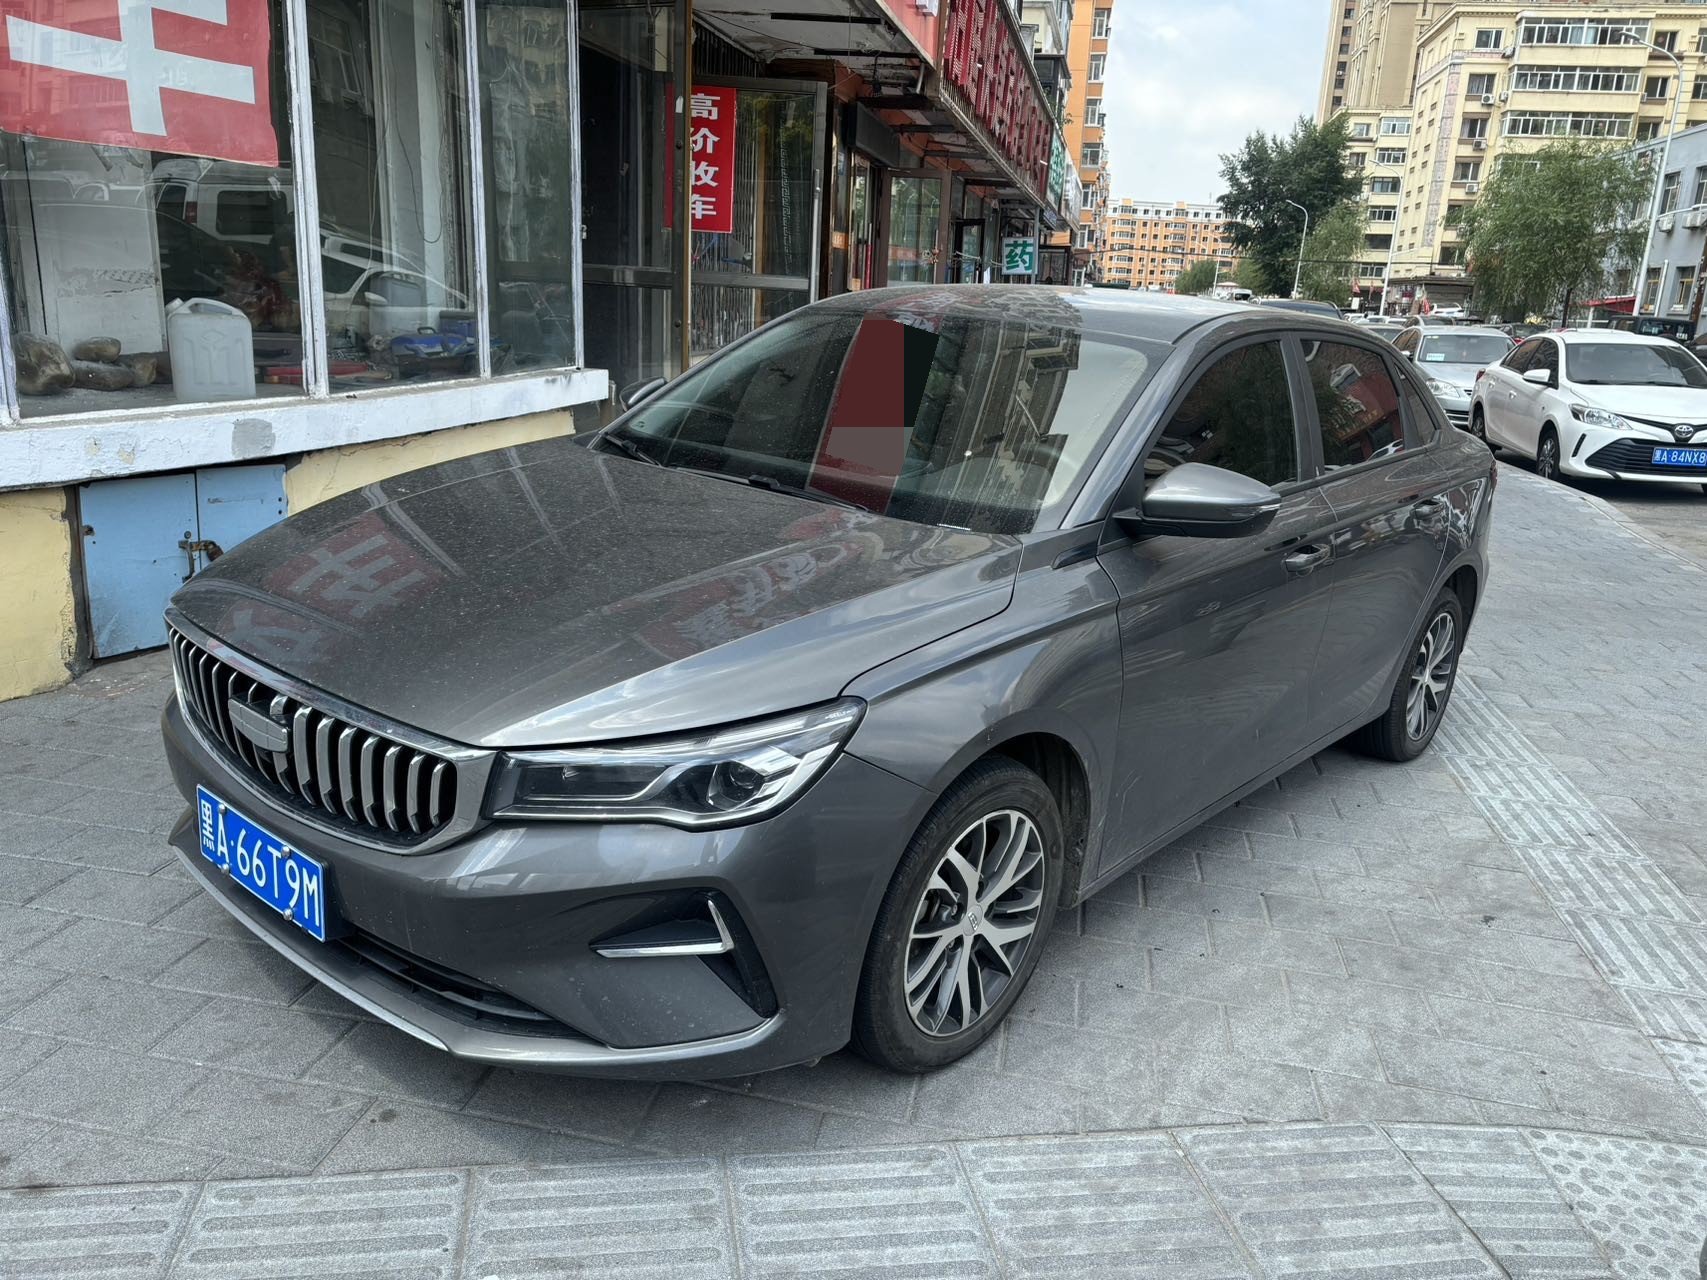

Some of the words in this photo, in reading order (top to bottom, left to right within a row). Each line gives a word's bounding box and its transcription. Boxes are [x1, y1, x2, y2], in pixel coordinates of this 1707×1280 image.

[690, 93, 721, 220] 高价收车
[1004, 240, 1033, 272] 药
